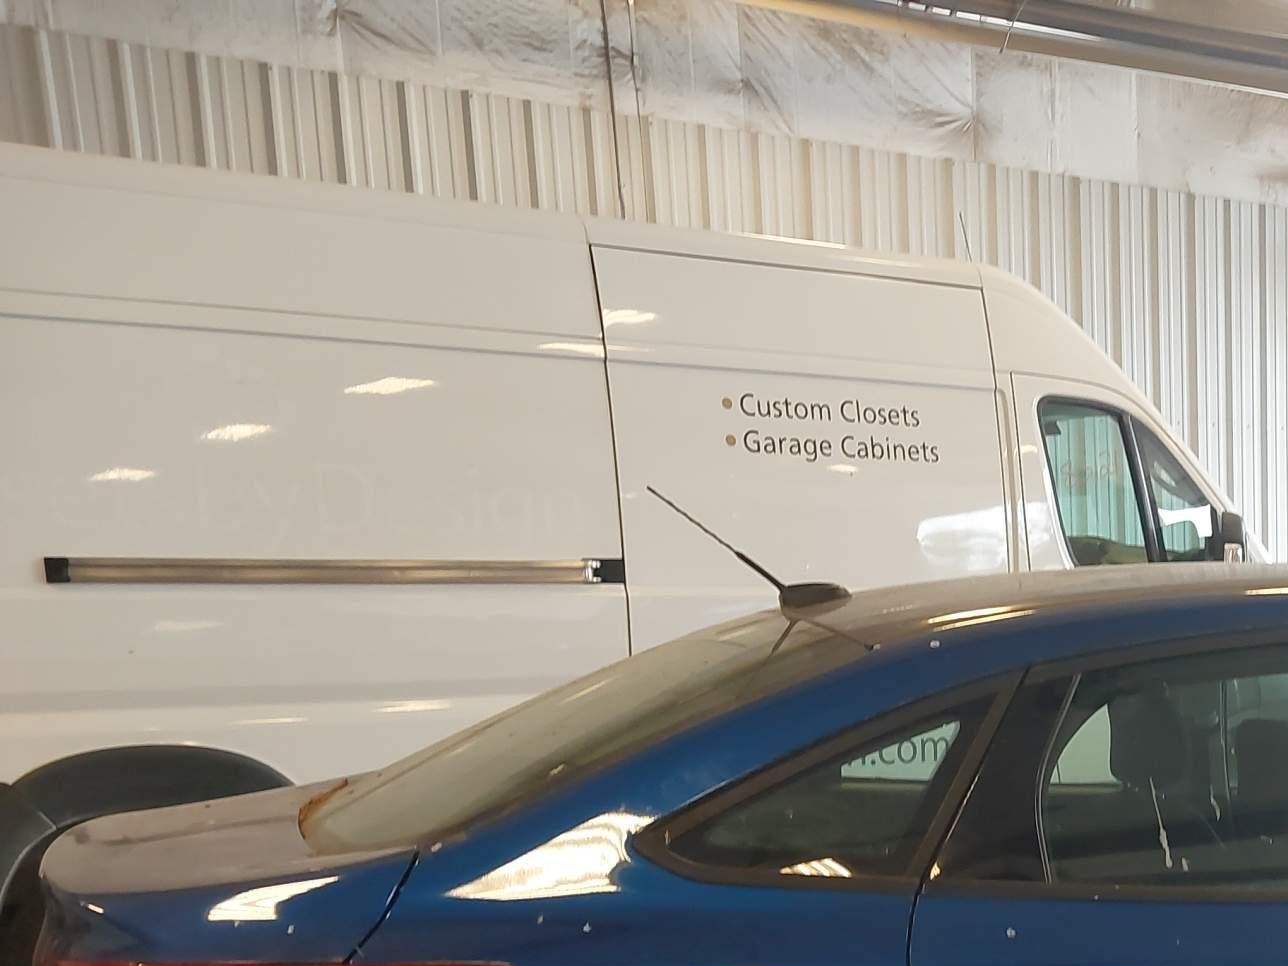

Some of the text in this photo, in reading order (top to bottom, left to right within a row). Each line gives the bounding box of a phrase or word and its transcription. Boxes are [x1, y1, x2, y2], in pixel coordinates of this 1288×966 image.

[739, 392, 921, 428] Custom Closets
[743, 429, 940, 463] Garage Cabinets
